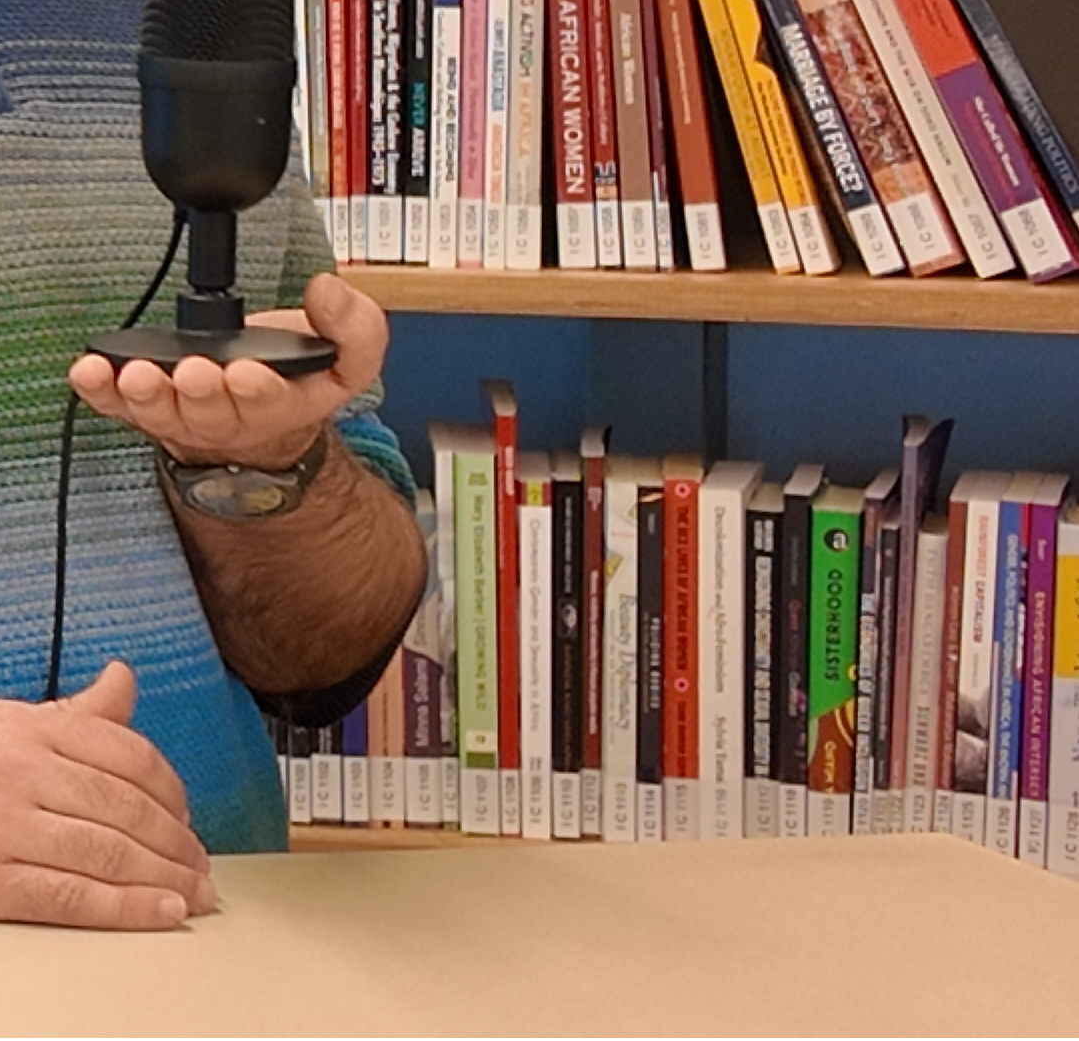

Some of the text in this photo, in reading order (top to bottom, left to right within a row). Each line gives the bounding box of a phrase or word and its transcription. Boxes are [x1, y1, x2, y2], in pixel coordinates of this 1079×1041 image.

[518, 10, 535, 79] ACTIVISM
[619, 12, 635, 106] African Women
[780, 23, 826, 110] MARRIAGE
[411, 82, 425, 177] NEVER ARRIVE
[518, 102, 532, 159] AFRICA
[557, 0, 586, 195] AFRICAN WOMEN
[813, 108, 837, 133] BY
[821, 124, 865, 194] FORCE?
[1046, 136, 1079, 196] POLITICS
[675, 505, 690, 524] THE
[675, 526, 690, 546] SEX
[713, 505, 727, 590] Decolonization
[527, 518, 542, 584] Contemporary
[675, 547, 690, 575] LIVES
[972, 514, 991, 644] RAINFOREST CAPITALISM
[471, 493, 487, 711] Mary Elizabeth Barber GROWING WILD
[529, 586, 542, 623] Gender
[530, 624, 542, 643] and
[675, 590, 690, 633] AFRICAN
[788, 599, 801, 631] Queer
[823, 568, 843, 683] SISTERHOOD
[1032, 591, 1046, 675] ENVISIONING
[528, 644, 542, 686] Sexuality
[615, 592, 635, 731] Beauty Diplomacy
[675, 634, 690, 671] WOMEN
[713, 610, 728, 693] Afro-Feminism
[413, 656, 429, 747] Minna Salami
[529, 701, 542, 731] Africa
[1029, 677, 1044, 735] AFRICAN
